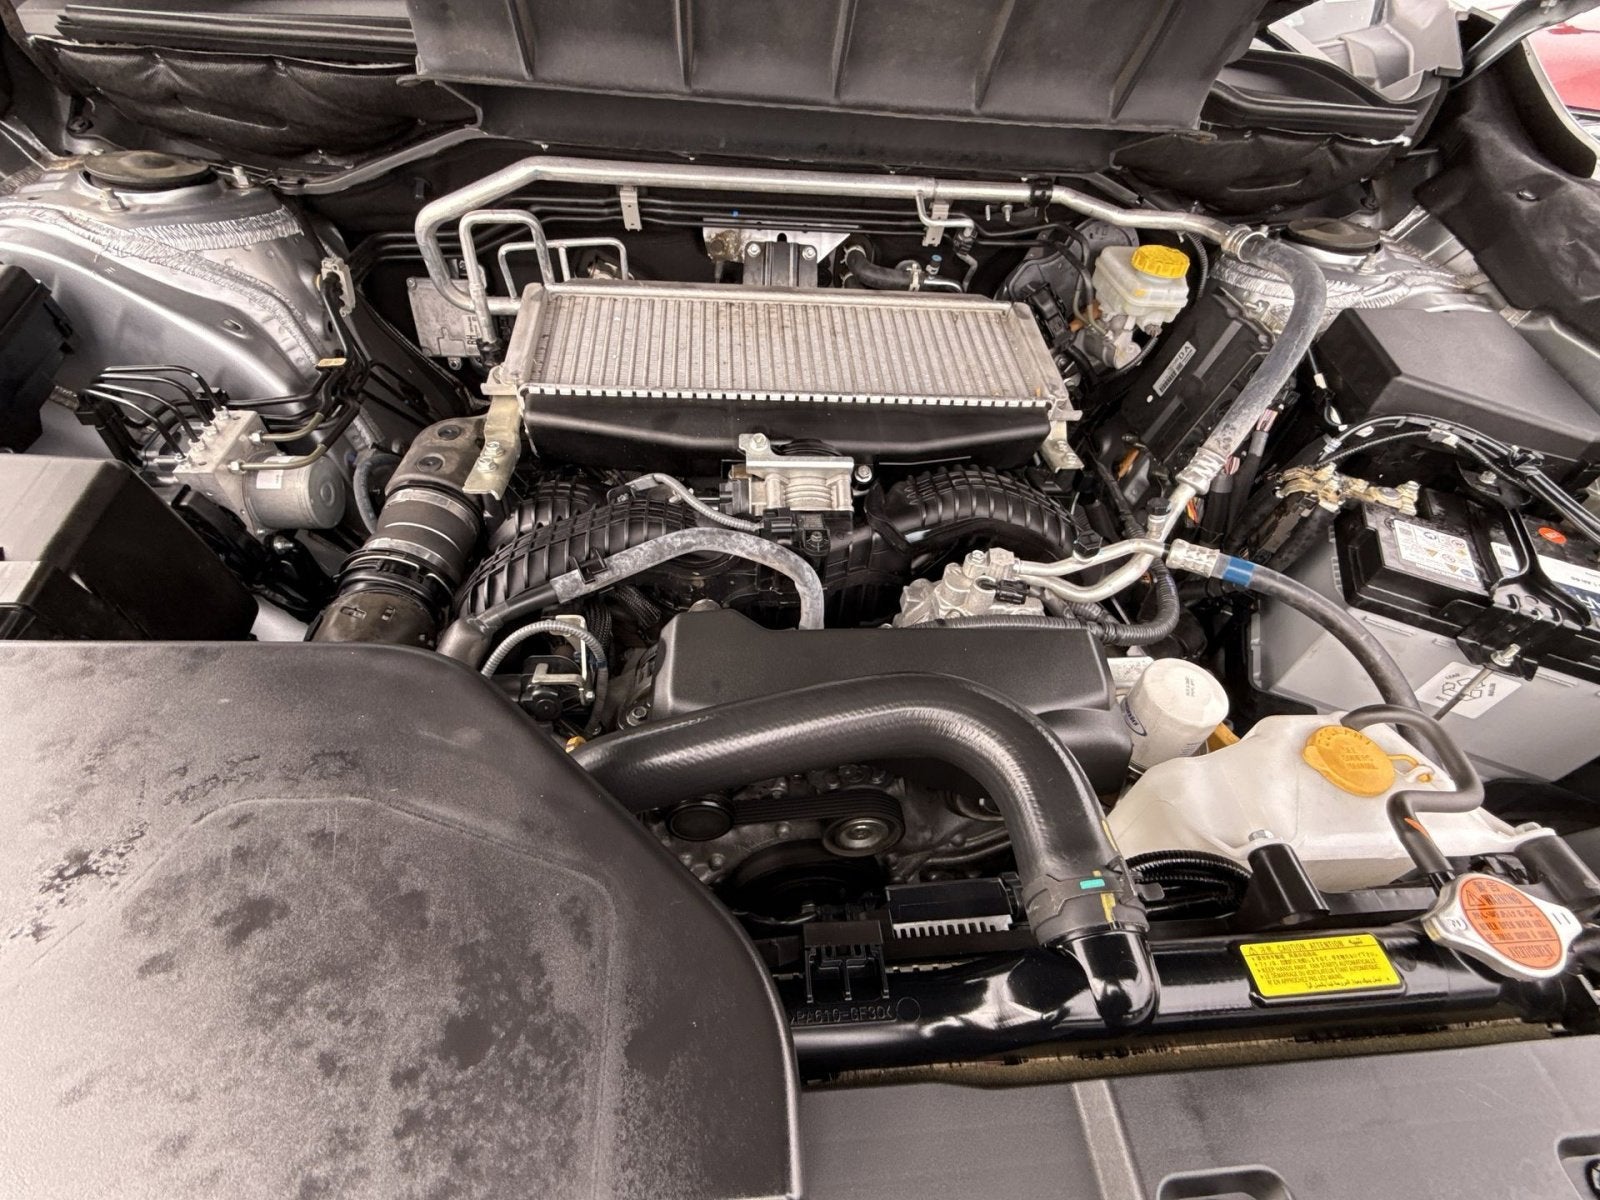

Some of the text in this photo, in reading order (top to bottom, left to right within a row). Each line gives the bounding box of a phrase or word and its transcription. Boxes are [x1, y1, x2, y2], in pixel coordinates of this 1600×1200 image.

[466, 334, 477, 345] RH
[1480, 893, 1522, 906] WARNING
[1277, 940, 1345, 952] CAUTION ATTENTION
